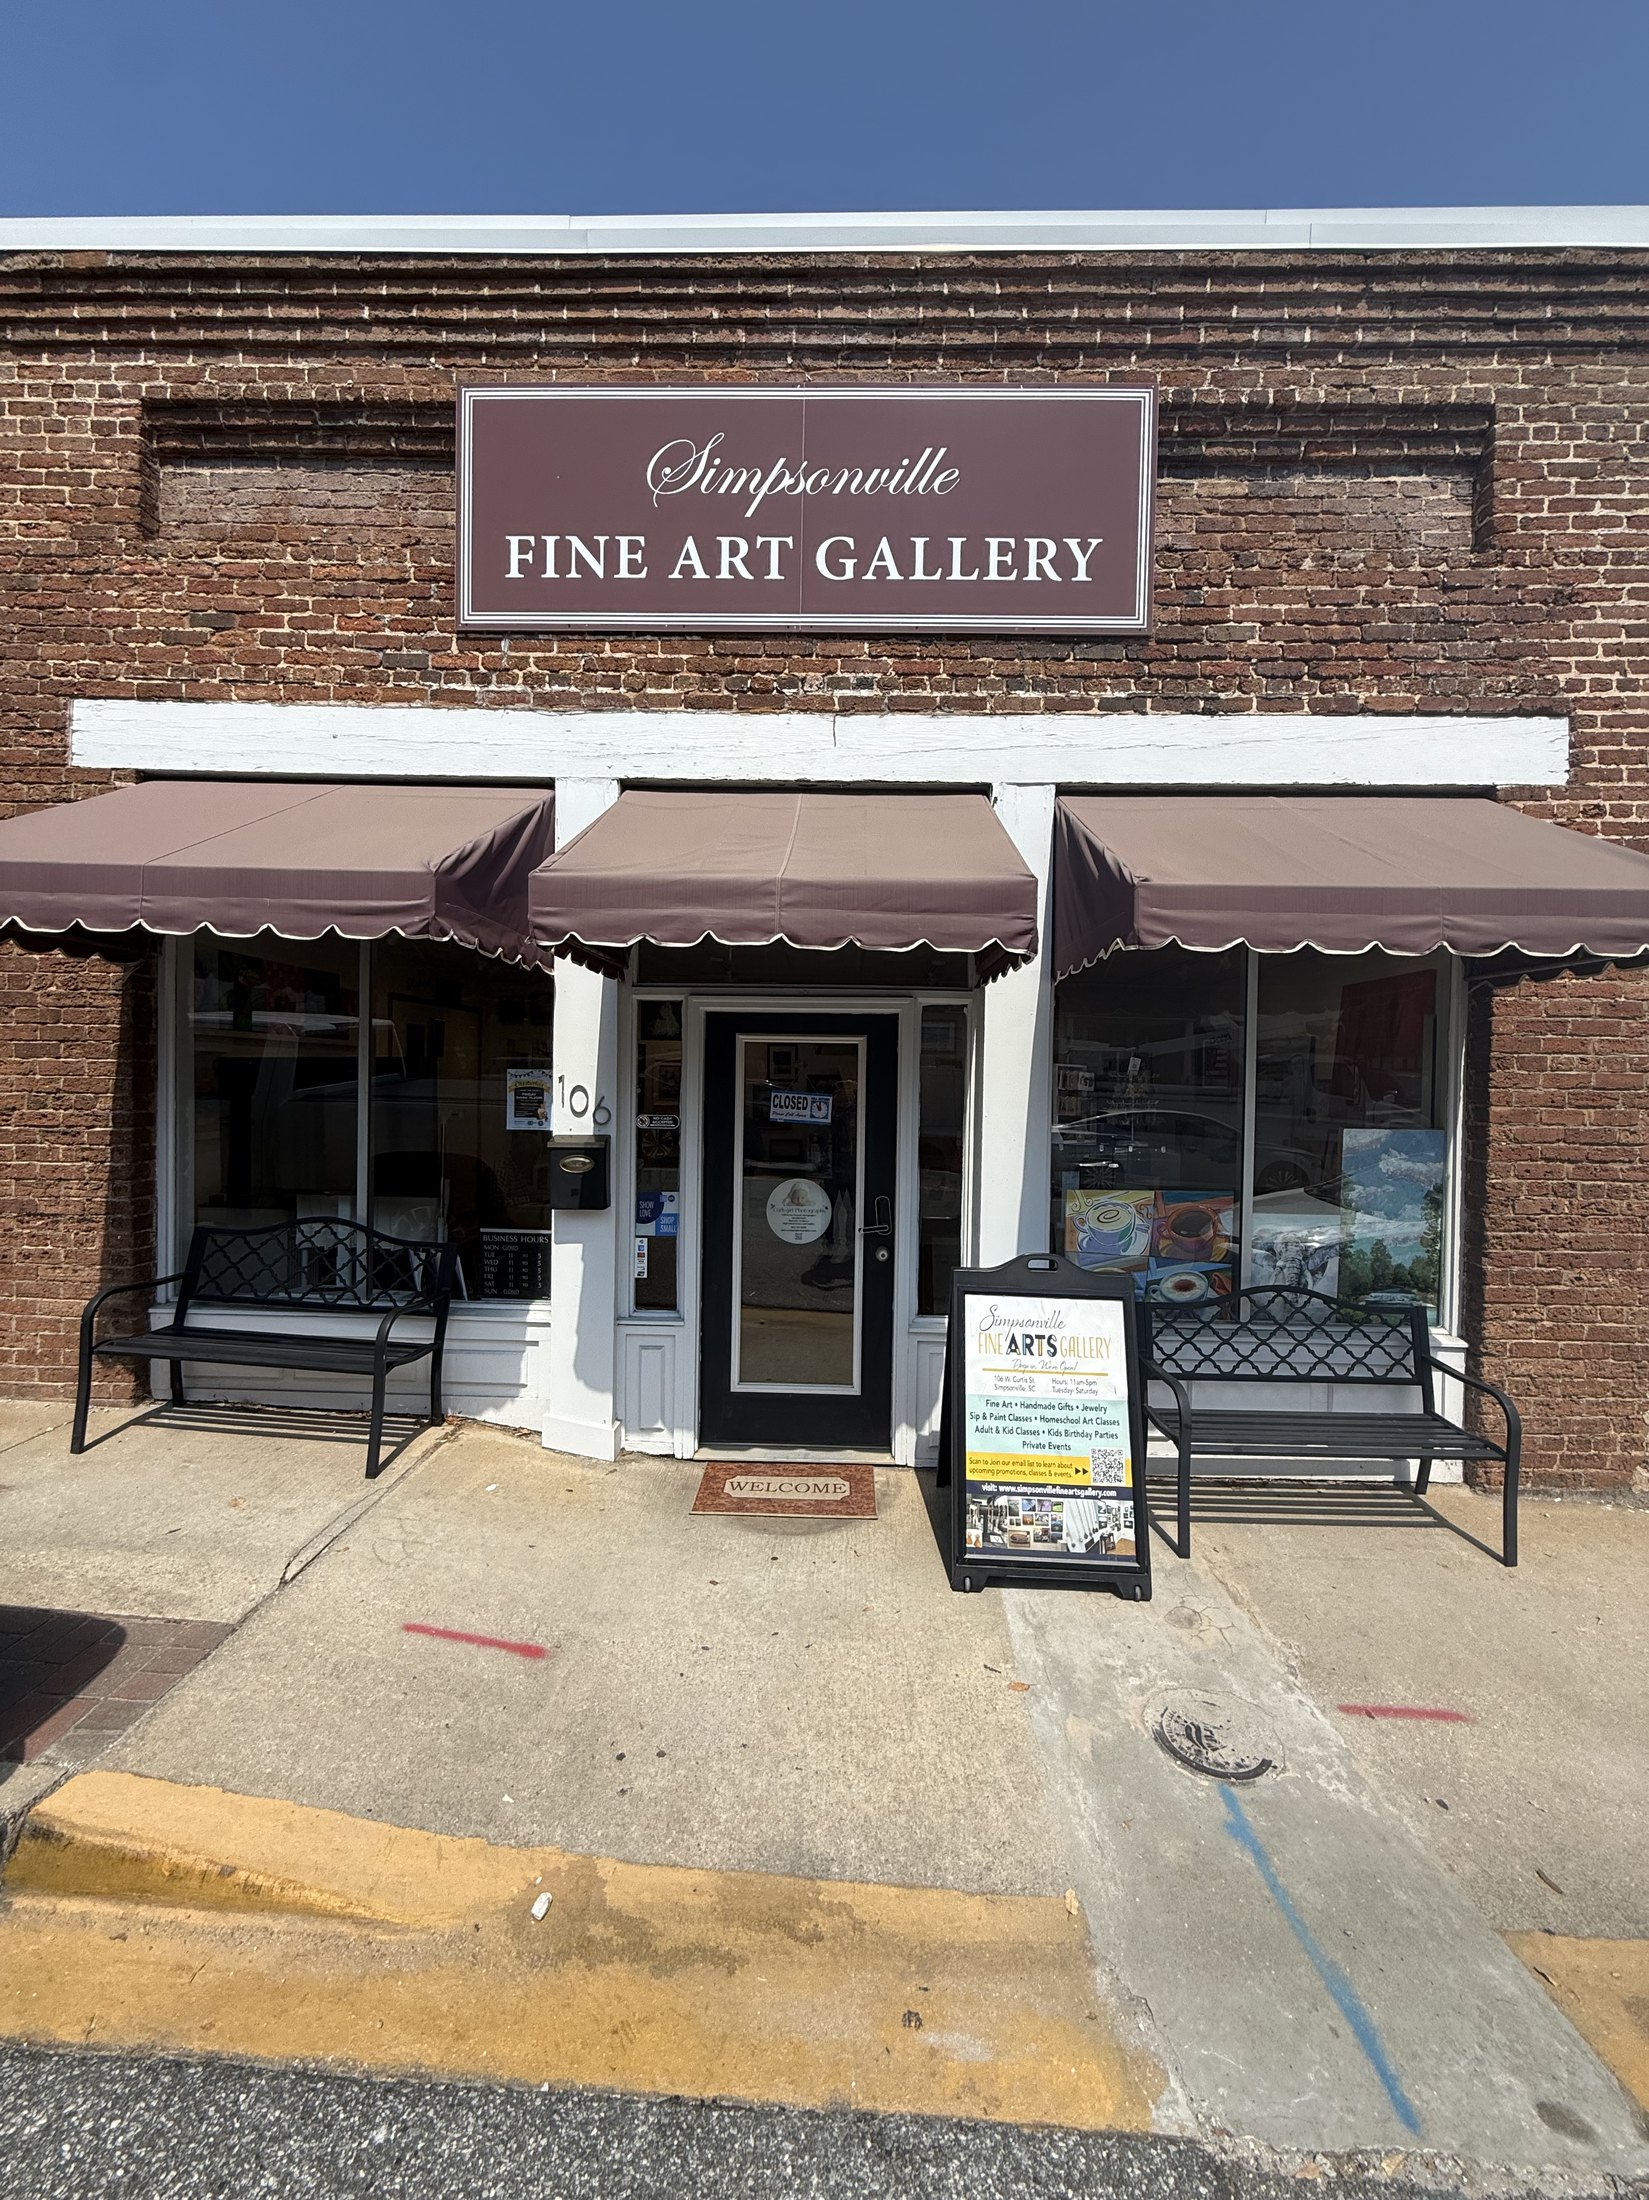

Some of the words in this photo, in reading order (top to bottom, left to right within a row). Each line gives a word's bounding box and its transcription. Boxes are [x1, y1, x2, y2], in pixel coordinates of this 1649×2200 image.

[645, 432, 961, 518] Simpsonville
[504, 534, 648, 579] FINE
[668, 535, 794, 581] ART
[814, 536, 1104, 582] GALLERY
[558, 1074, 612, 1126] 106
[773, 1094, 809, 1111] CLOSED
[639, 1201, 654, 1209] SHOW
[660, 1216, 675, 1224] SHOP
[482, 1234, 518, 1243] BUSINESS
[520, 1235, 549, 1243] HOURS
[979, 1304, 1067, 1342] Simpsonville
[978, 1332, 1004, 1355] FINE
[1005, 1332, 1058, 1358] ARTS
[1060, 1336, 1112, 1359] GALLERY
[1012, 1376, 1028, 1384] Curtis
[1075, 1387, 1099, 1397] Saturday
[985, 1399, 1000, 1408] Fine
[1001, 1400, 1013, 1409] Art
[1020, 1401, 1056, 1410] Handmade
[1057, 1402, 1074, 1411] Gifts
[1081, 1403, 1108, 1415] Jewelry
[969, 1411, 980, 1422] Sip
[982, 1412, 987, 1421] &
[989, 1412, 1006, 1421] Paint
[1008, 1413, 1033, 1423] Classes
[1039, 1414, 1081, 1425] Homeschool
[1082, 1416, 1094, 1425] Art
[1095, 1416, 1120, 1426] Classes
[974, 1425, 994, 1434] Adult
[995, 1426, 1000, 1435] &
[1002, 1426, 1014, 1435] Kid
[1015, 1427, 1040, 1436] Classes
[1047, 1428, 1063, 1437] Kids
[1064, 1429, 1093, 1441] Birthday
[1094, 1430, 1119, 1440] Parties
[1022, 1440, 1046, 1450] Private
[1048, 1441, 1072, 1451] Events
[969, 1457, 982, 1465] Scan
[982, 1458, 989, 1466] to
[1001, 1459, 1011, 1467] our
[1011, 1459, 1026, 1467] email
[1027, 1459, 1035, 1468] list
[1035, 1460, 1042, 1468] to
[1057, 1461, 1074, 1469] about
[969, 1467, 995, 1477] upcoming
[1028, 1469, 1048, 1477] classes
[729, 1481, 847, 1494] WELCOME
[981, 1482, 998, 1492] visit:
[998, 1484, 1117, 1499] www.simpsonvillefineartsgallery.com
